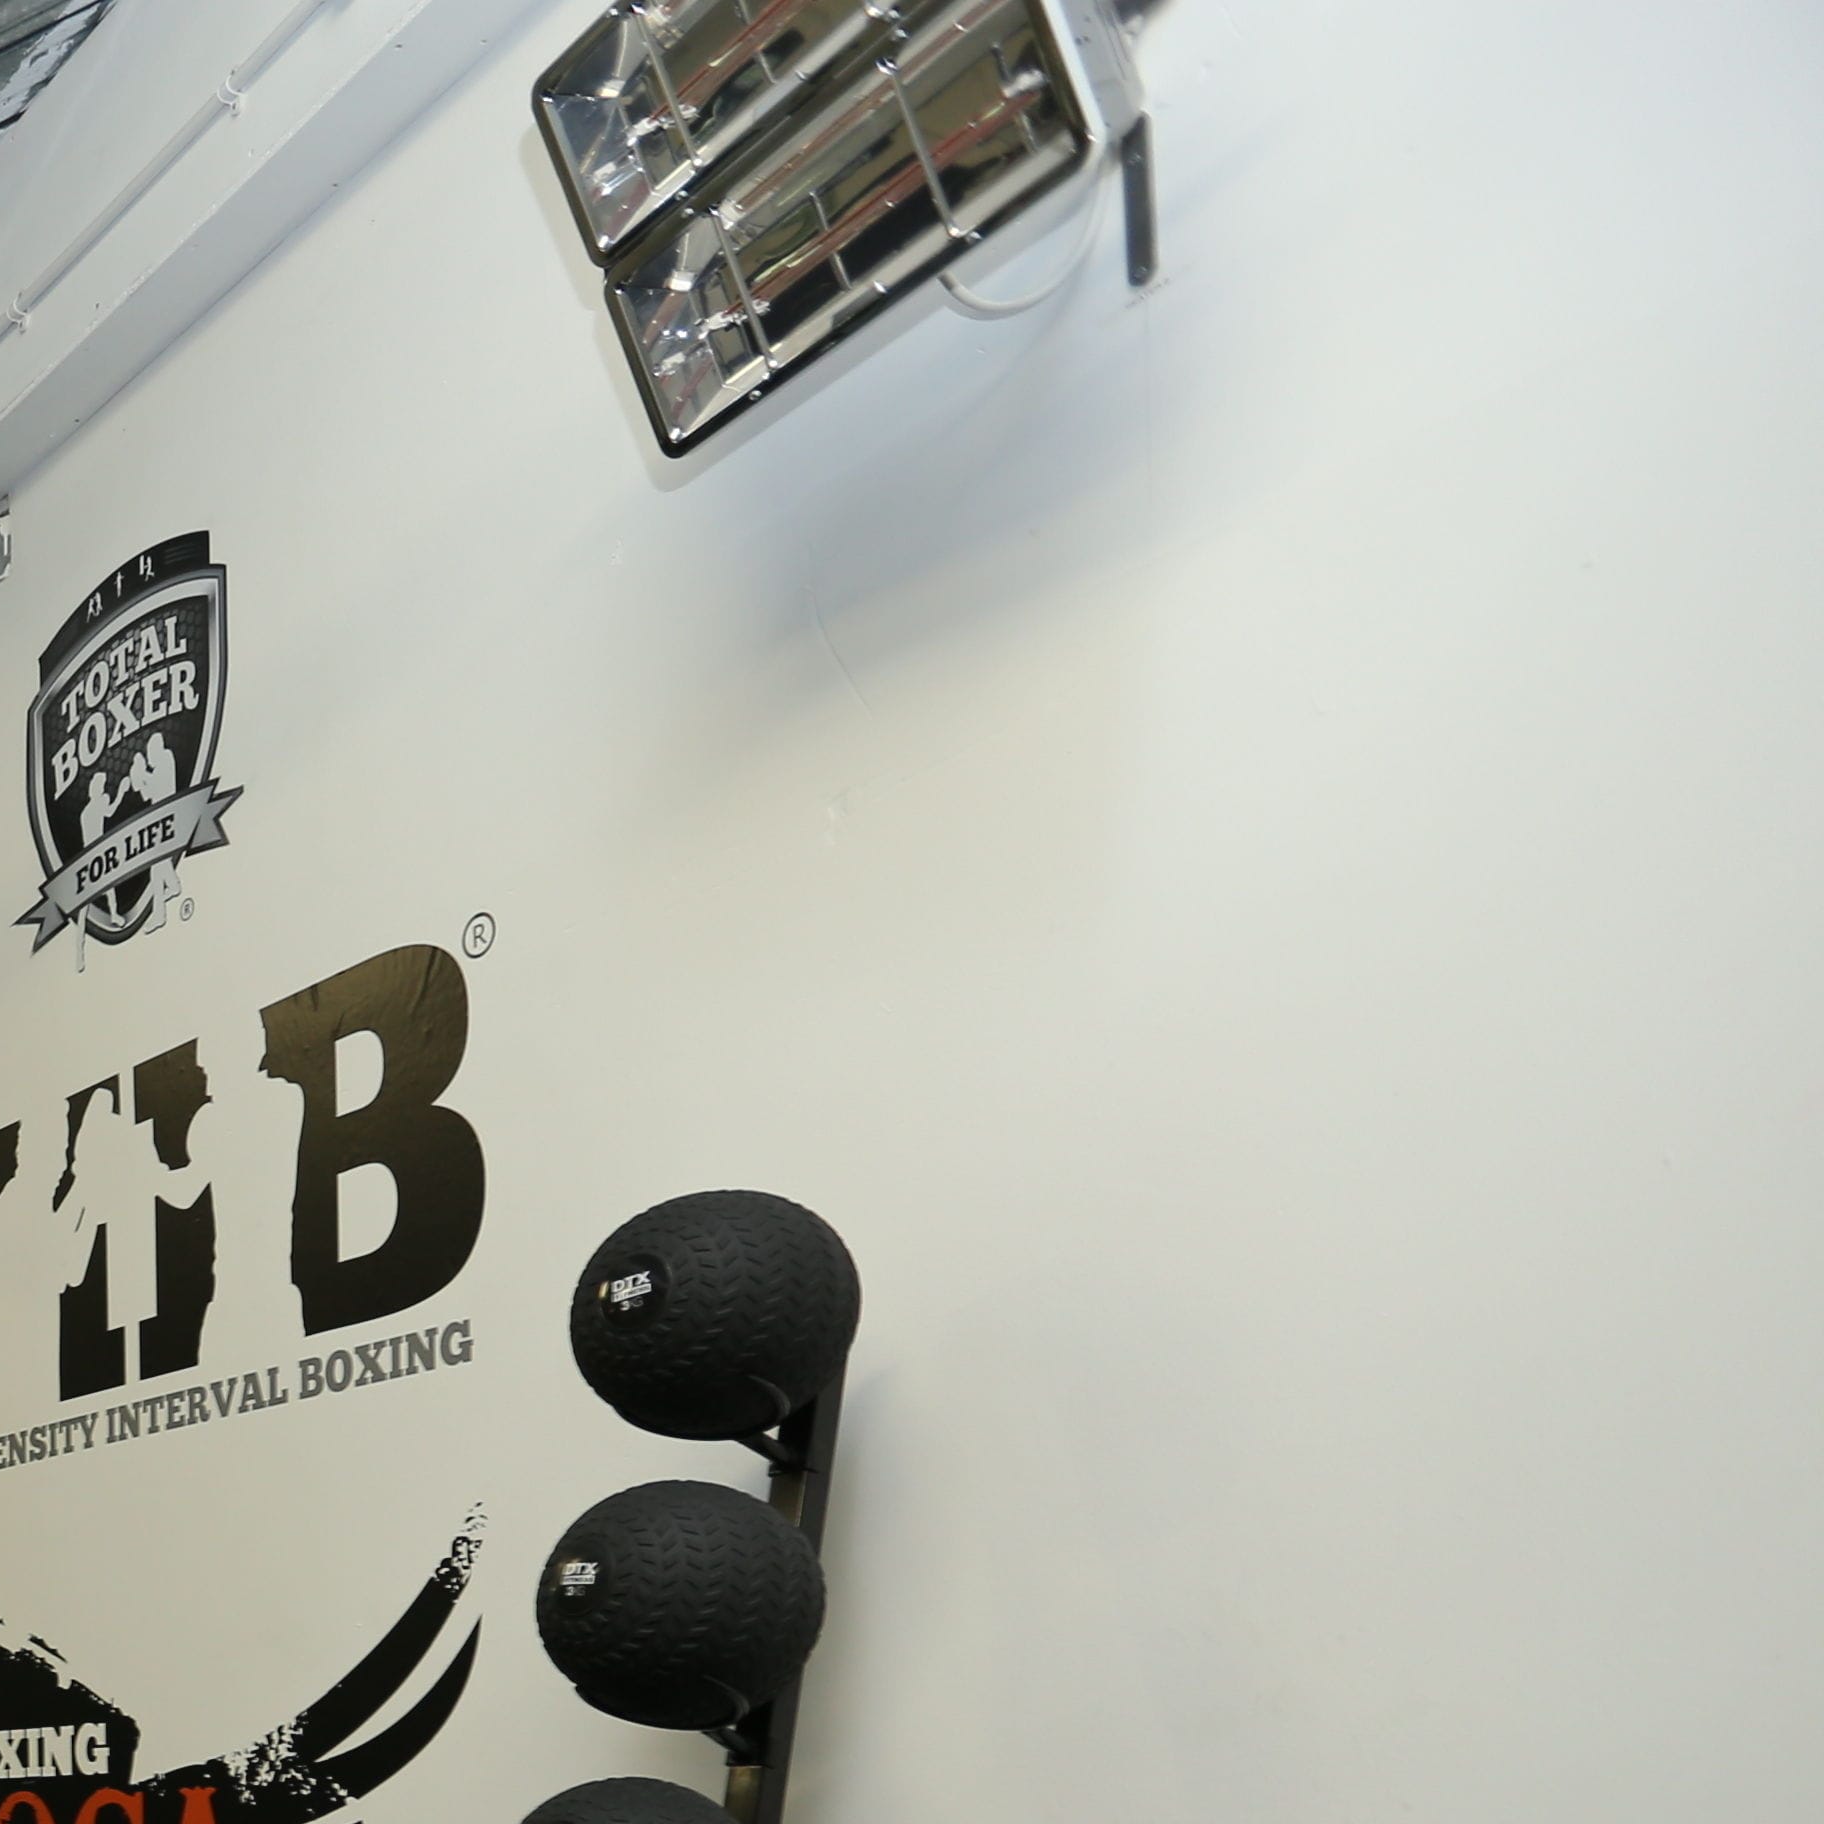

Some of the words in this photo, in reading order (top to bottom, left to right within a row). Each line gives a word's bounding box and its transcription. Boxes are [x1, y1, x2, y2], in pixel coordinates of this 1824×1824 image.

[61, 615, 187, 733] TOTAL
[52, 660, 199, 800] BOXER
[76, 850, 119, 894] FOR
[126, 814, 175, 861] LIFE
[611, 1270, 651, 1293] DTX
[106, 1366, 289, 1444] INTERVAL
[298, 1319, 474, 1399] BOXING
[562, 1562, 599, 1576] DTX
